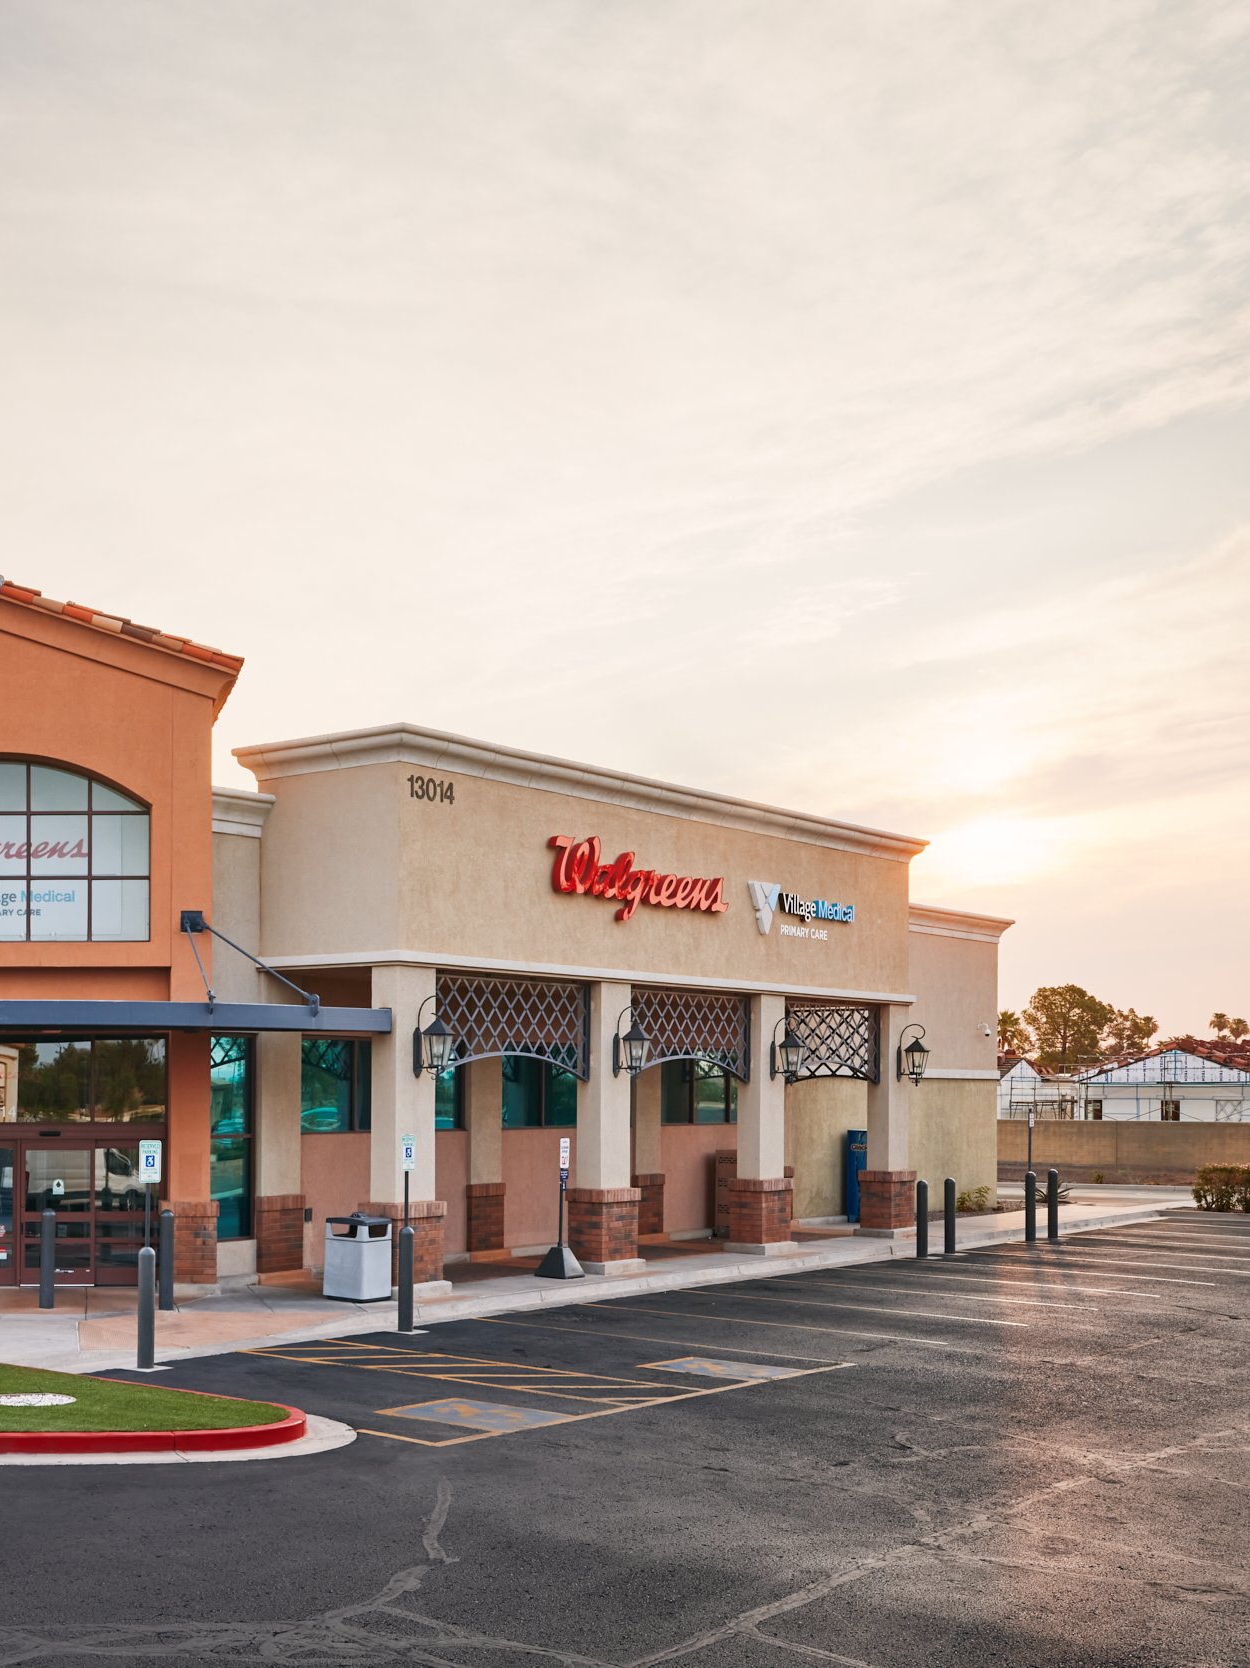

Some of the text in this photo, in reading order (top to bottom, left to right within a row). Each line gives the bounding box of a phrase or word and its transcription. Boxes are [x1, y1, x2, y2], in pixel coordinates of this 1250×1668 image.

[407, 774, 455, 805] 13014
[549, 835, 729, 921] Walgreens
[21, 889, 75, 902] Medical
[781, 892, 855, 923] Village Medical
[16, 908, 42, 917] CARE
[780, 924, 828, 941] PRIMARY CARE
